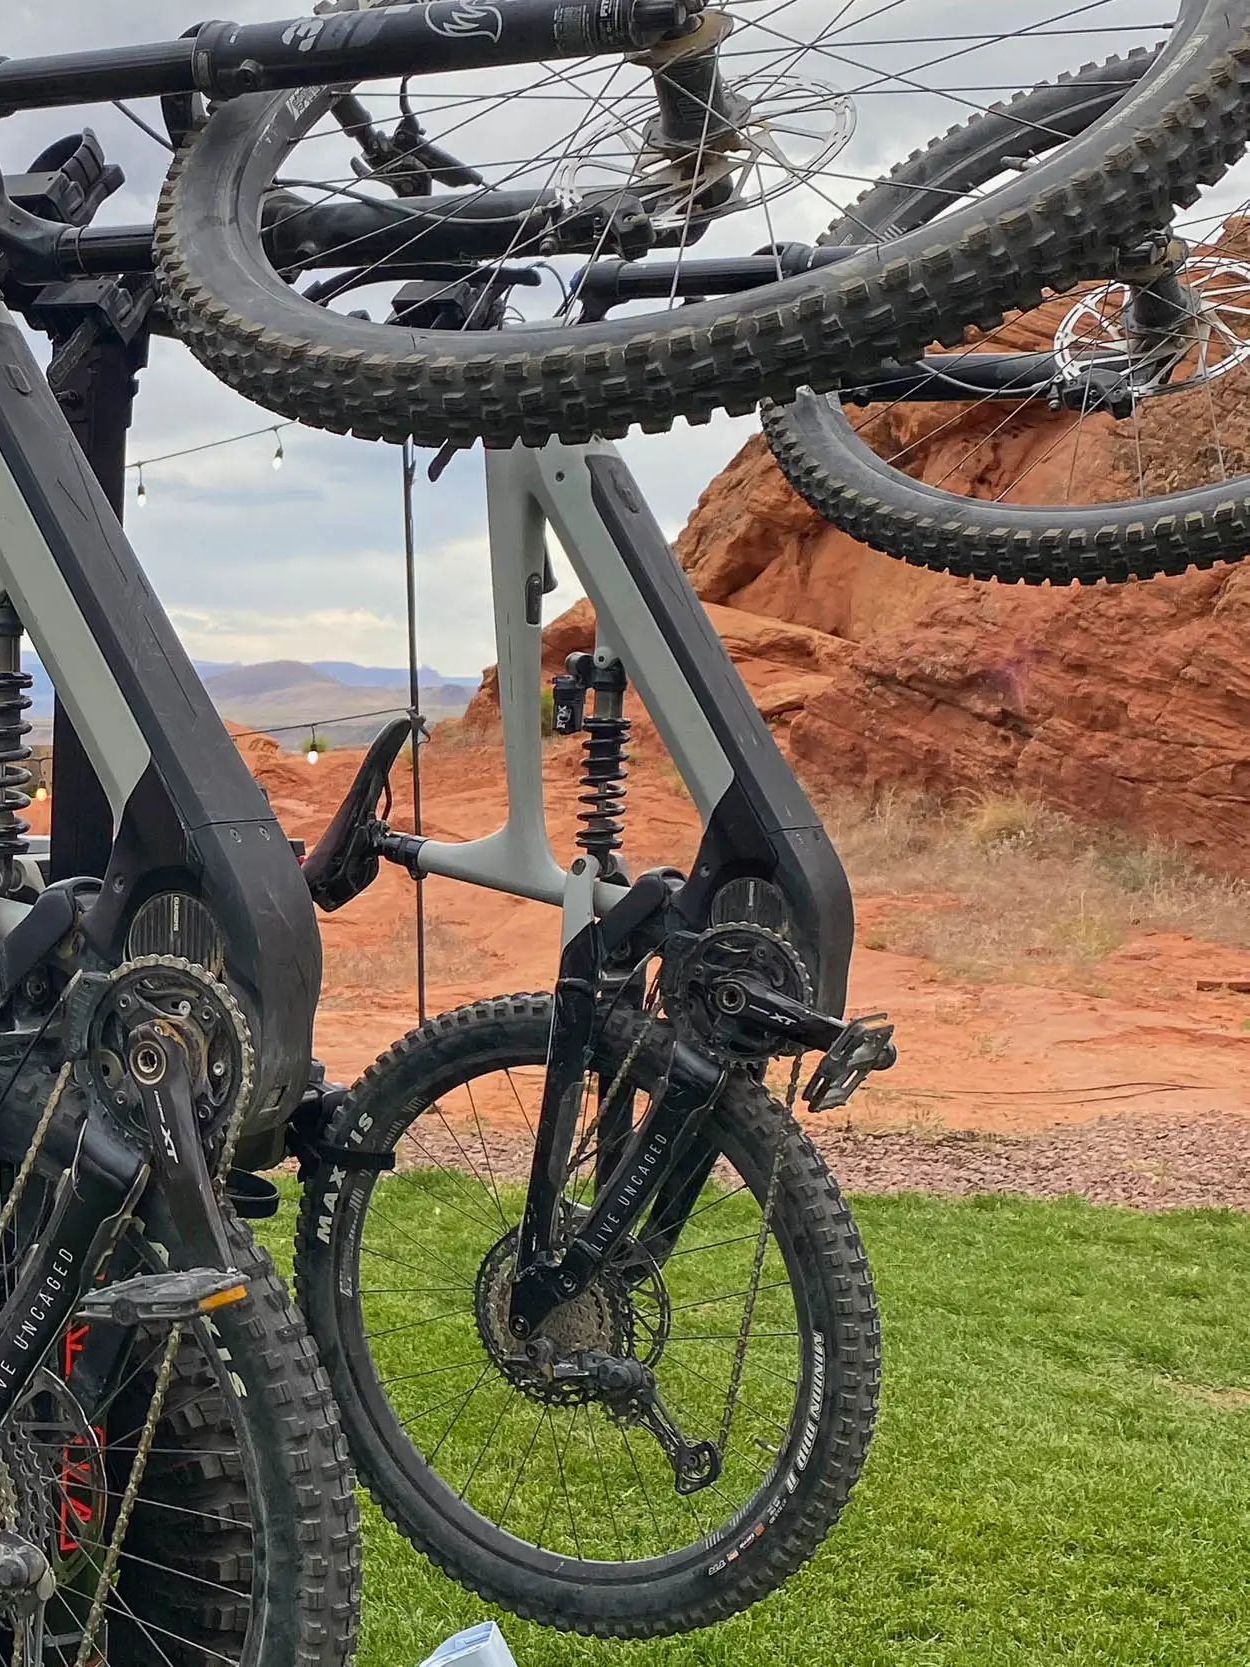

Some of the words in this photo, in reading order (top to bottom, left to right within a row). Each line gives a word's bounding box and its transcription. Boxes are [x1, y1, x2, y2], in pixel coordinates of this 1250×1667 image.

[556, 704, 570, 729] FOX
[769, 1013, 797, 1025] XT
[160, 1124, 179, 1164] XT
[316, 1112, 374, 1244] MAXIS
[590, 1213, 621, 1252] LIVE
[617, 1133, 668, 1207] UNCAGED
[13, 1247, 74, 1351] UNCAGED
